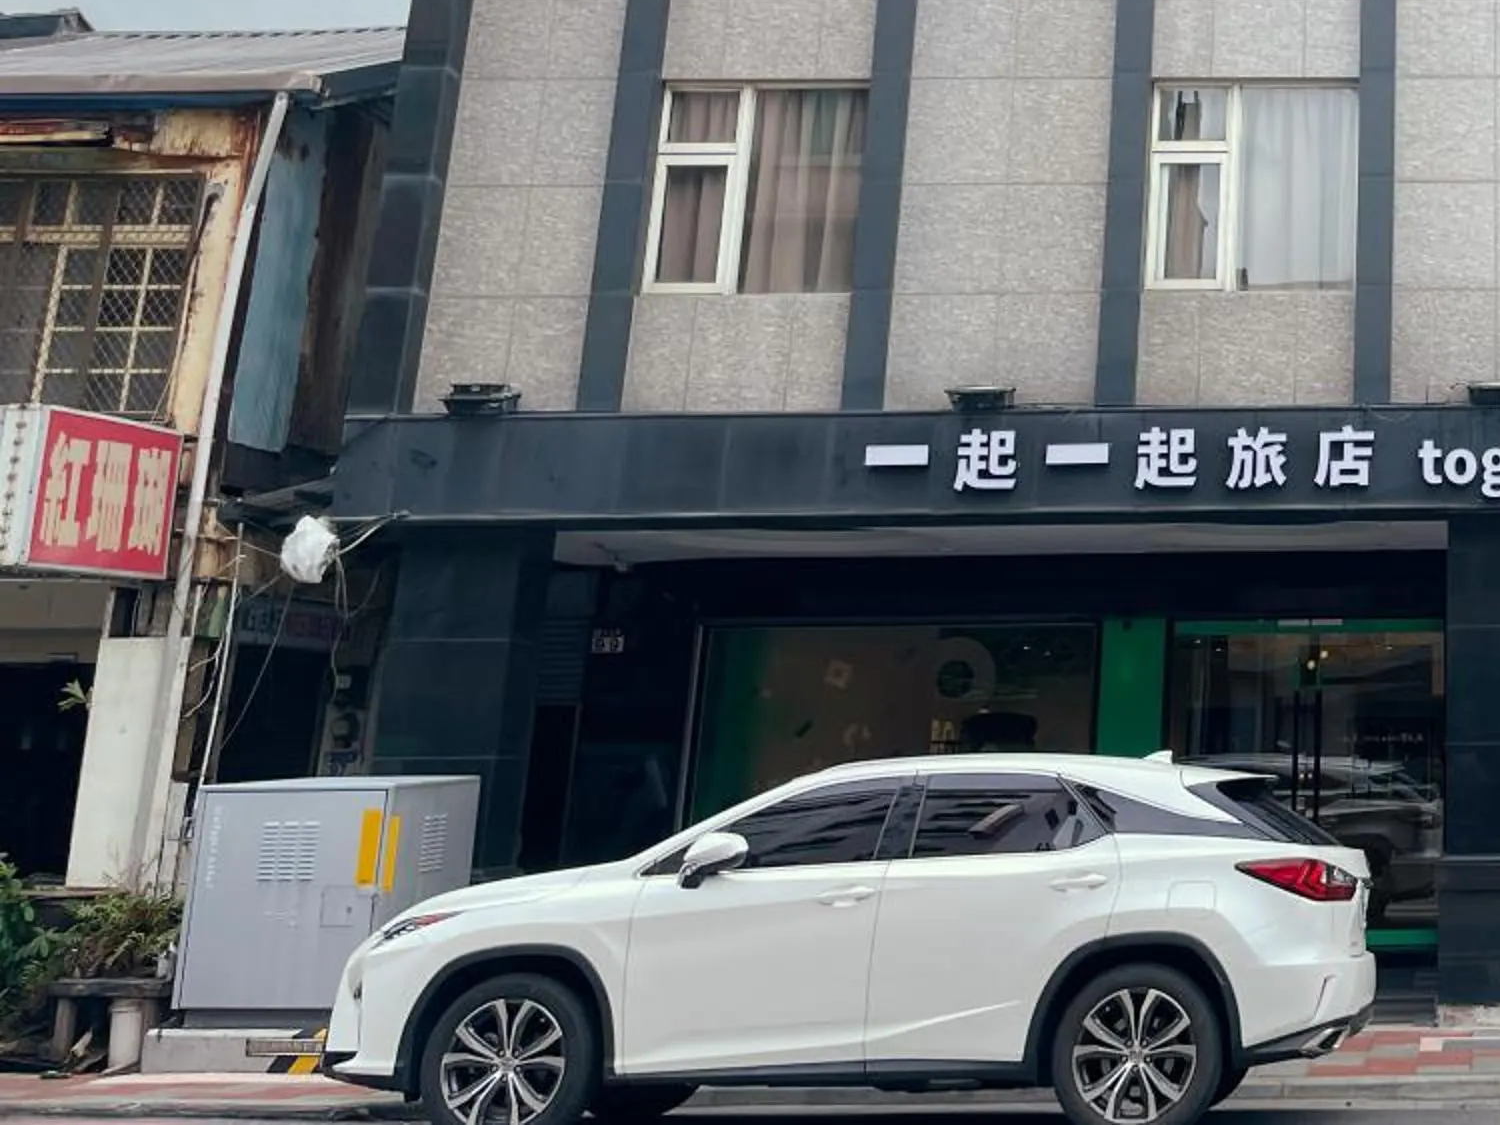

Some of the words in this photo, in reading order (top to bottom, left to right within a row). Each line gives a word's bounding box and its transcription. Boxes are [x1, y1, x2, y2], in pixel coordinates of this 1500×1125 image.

[39, 430, 172, 556] 紅珊瑚
[864, 425, 1376, 492] 一起一起旅店
